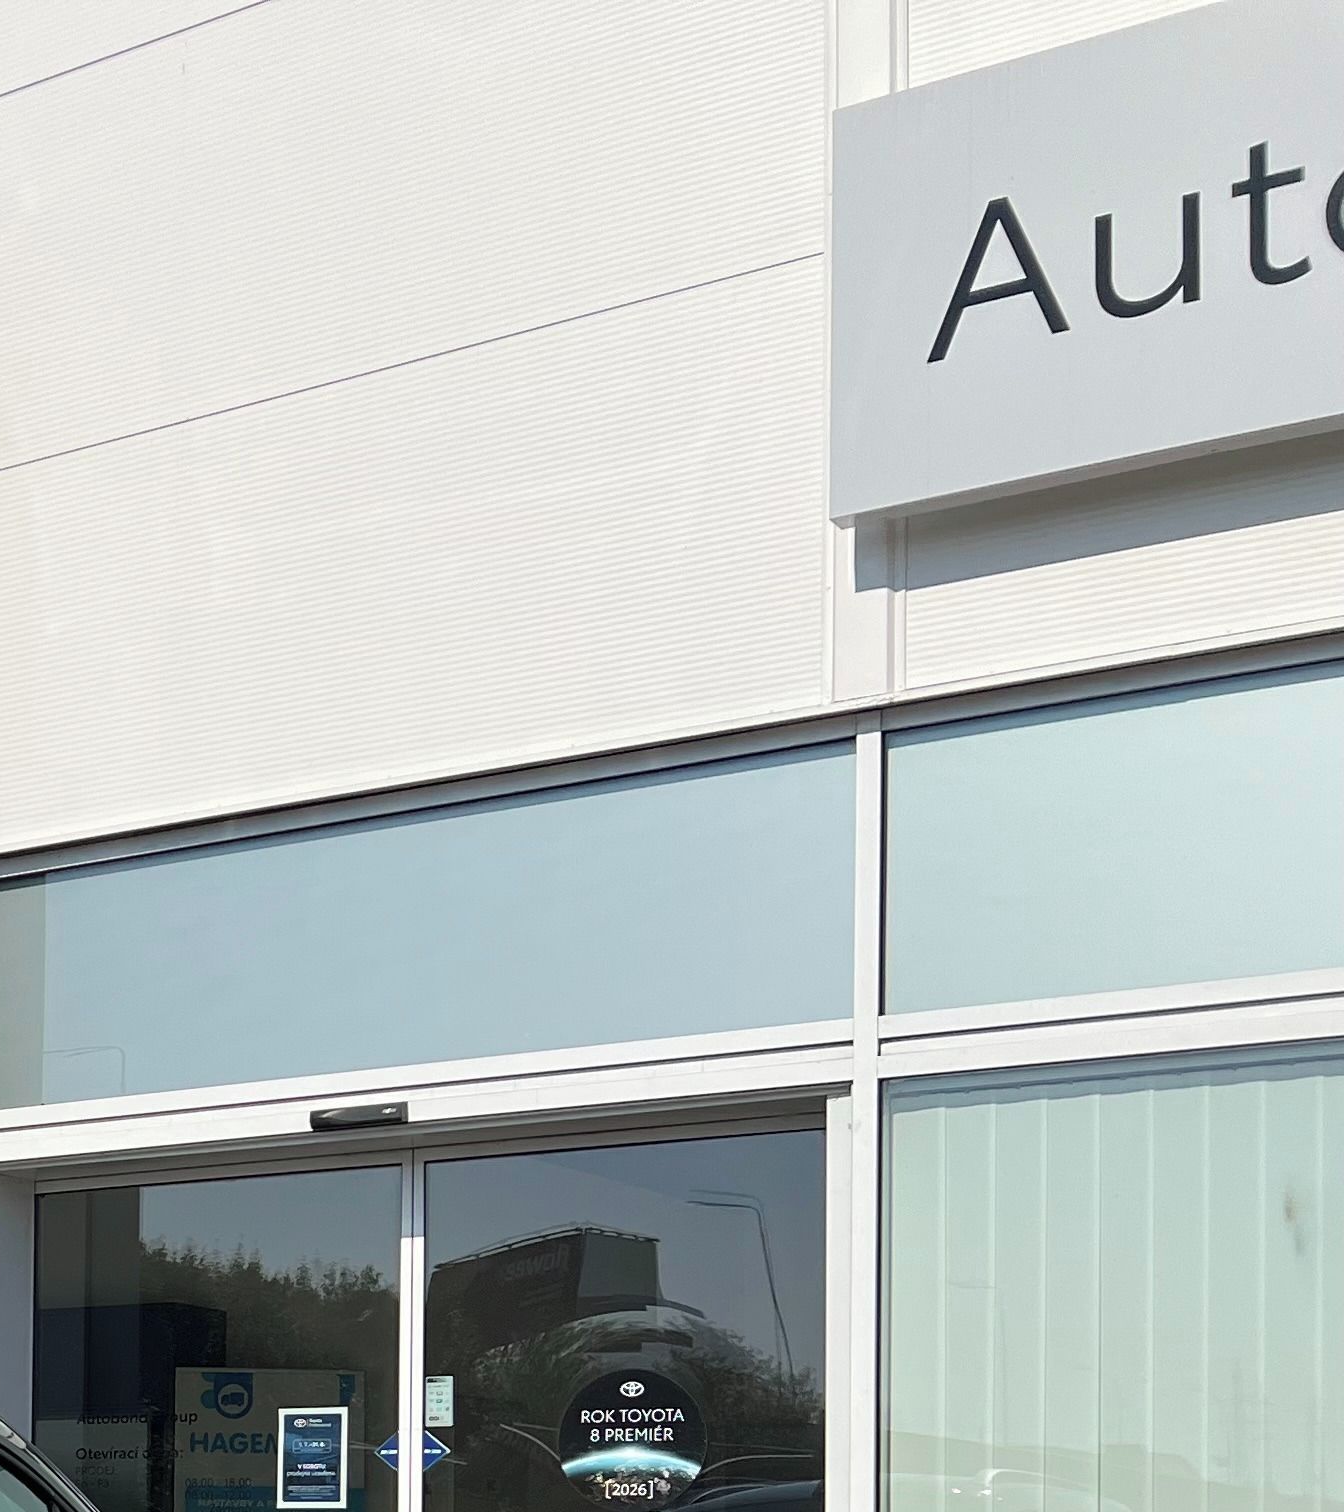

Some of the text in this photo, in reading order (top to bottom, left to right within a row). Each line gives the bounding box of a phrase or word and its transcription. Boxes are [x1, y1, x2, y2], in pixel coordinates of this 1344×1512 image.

[926, 140, 1344, 363] Aut
[580, 1408, 685, 1423] ROK TOYOTA
[589, 1424, 674, 1442] 8 PREMIÉR
[605, 1480, 654, 1499] [2026]
